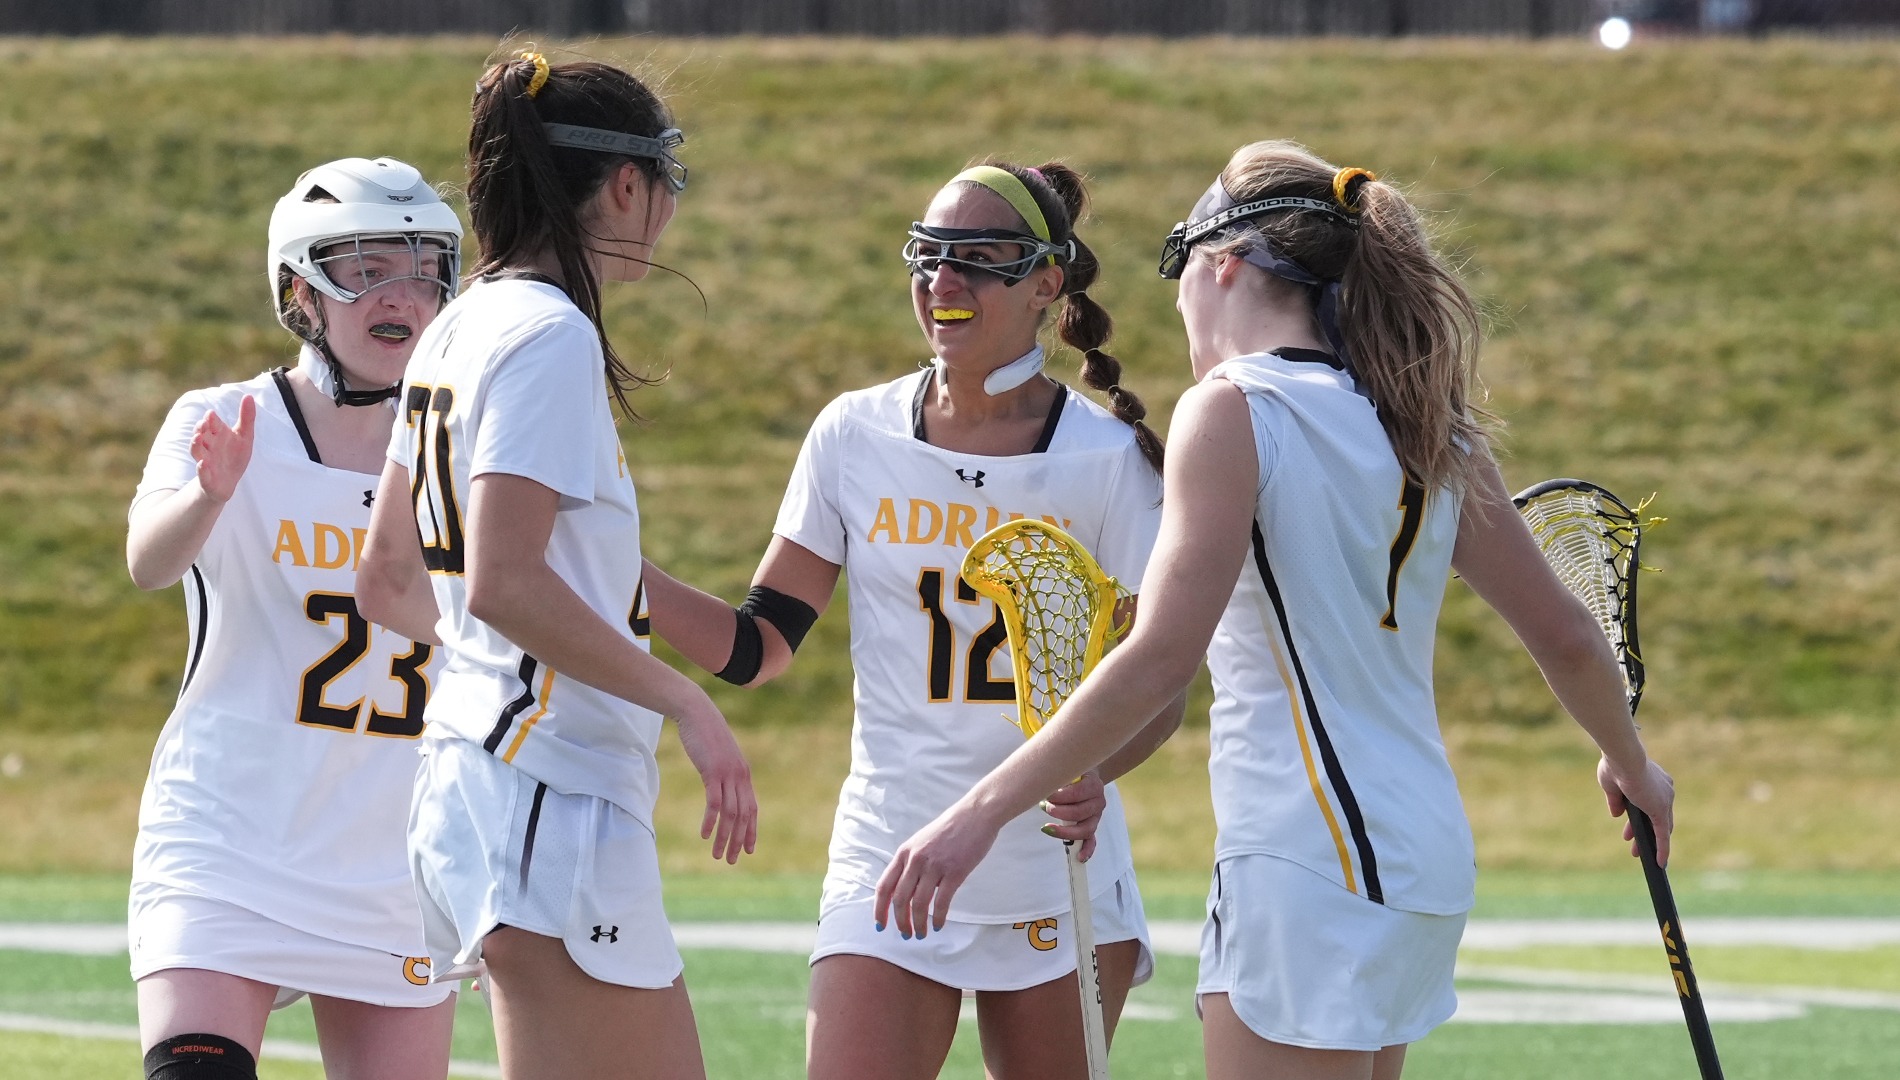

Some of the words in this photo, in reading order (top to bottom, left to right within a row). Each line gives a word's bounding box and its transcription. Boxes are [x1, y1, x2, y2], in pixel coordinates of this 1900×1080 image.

[567, 129, 617, 146] PRO
[1379, 466, 1428, 632] 1
[295, 589, 434, 740] 23
[916, 566, 1021, 704] 12
[172, 1045, 225, 1055] INCREDIWEAR
